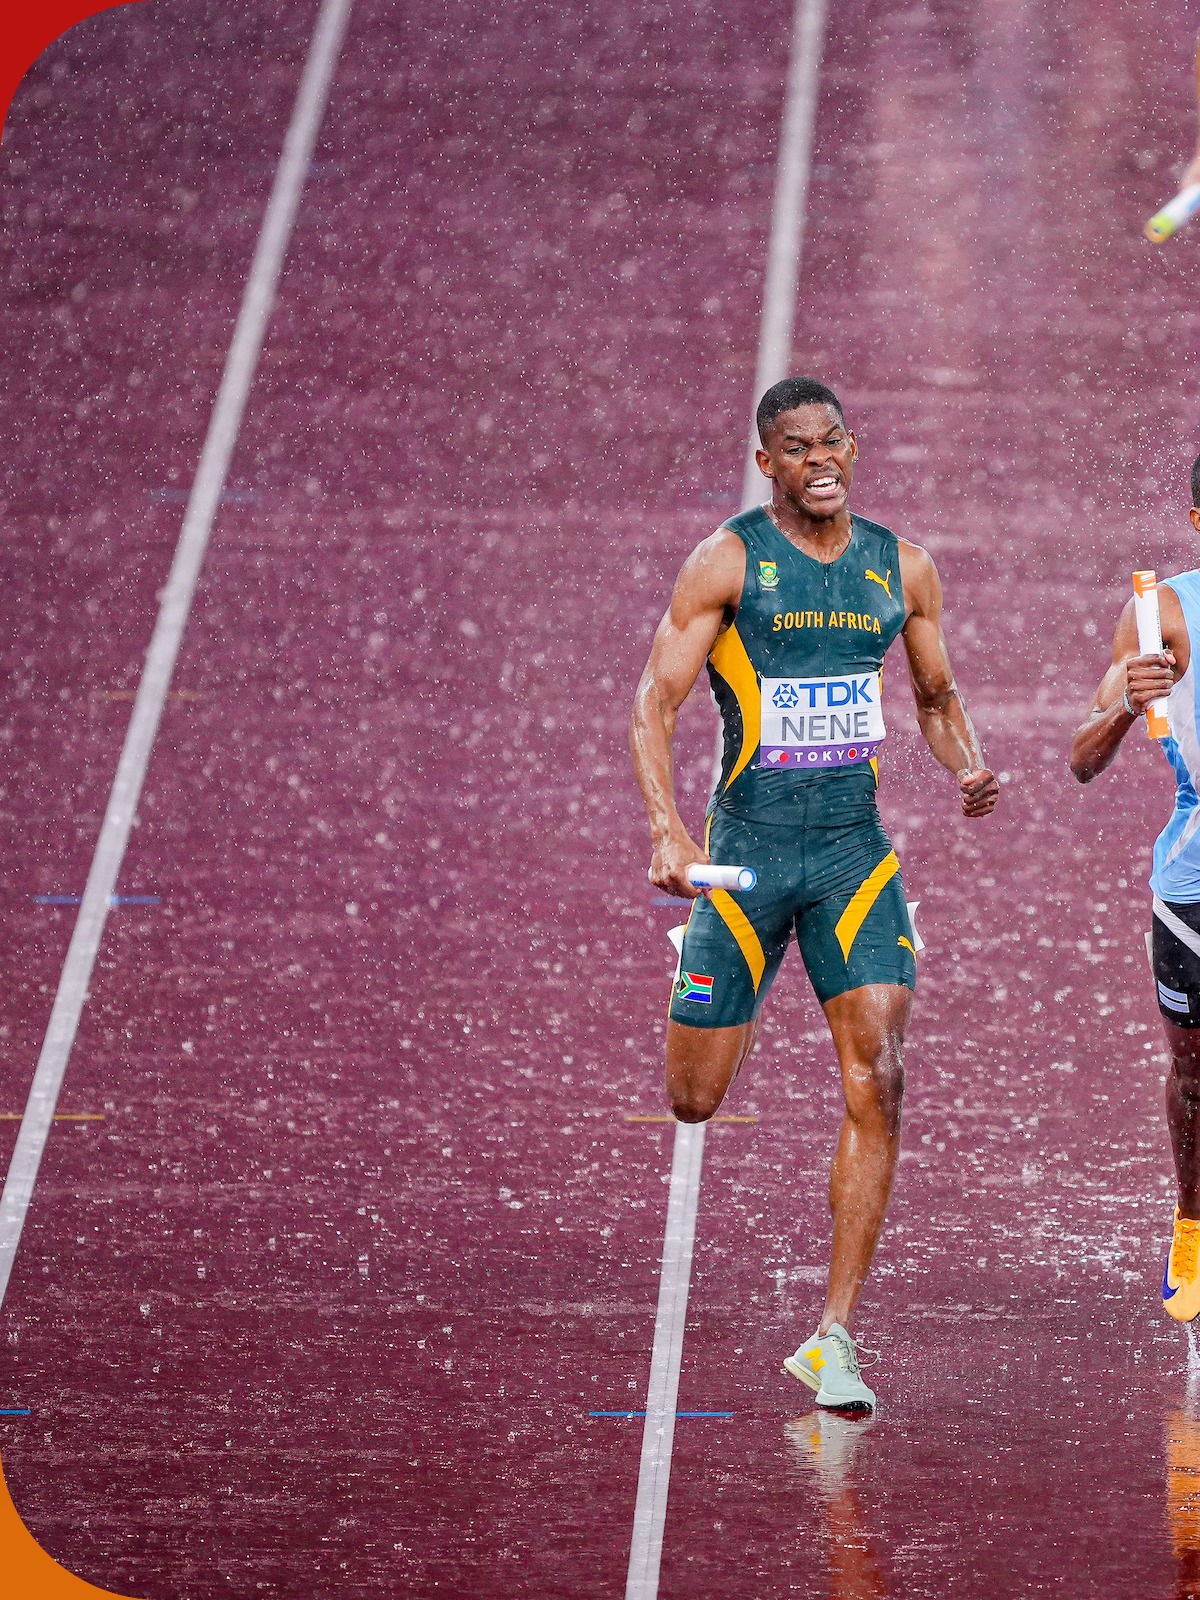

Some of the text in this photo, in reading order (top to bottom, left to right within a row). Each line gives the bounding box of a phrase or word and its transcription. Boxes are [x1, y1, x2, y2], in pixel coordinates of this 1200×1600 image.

[772, 610, 882, 634] SOUTH AFRICA
[799, 677, 874, 708] TDK
[781, 711, 870, 742] NENE
